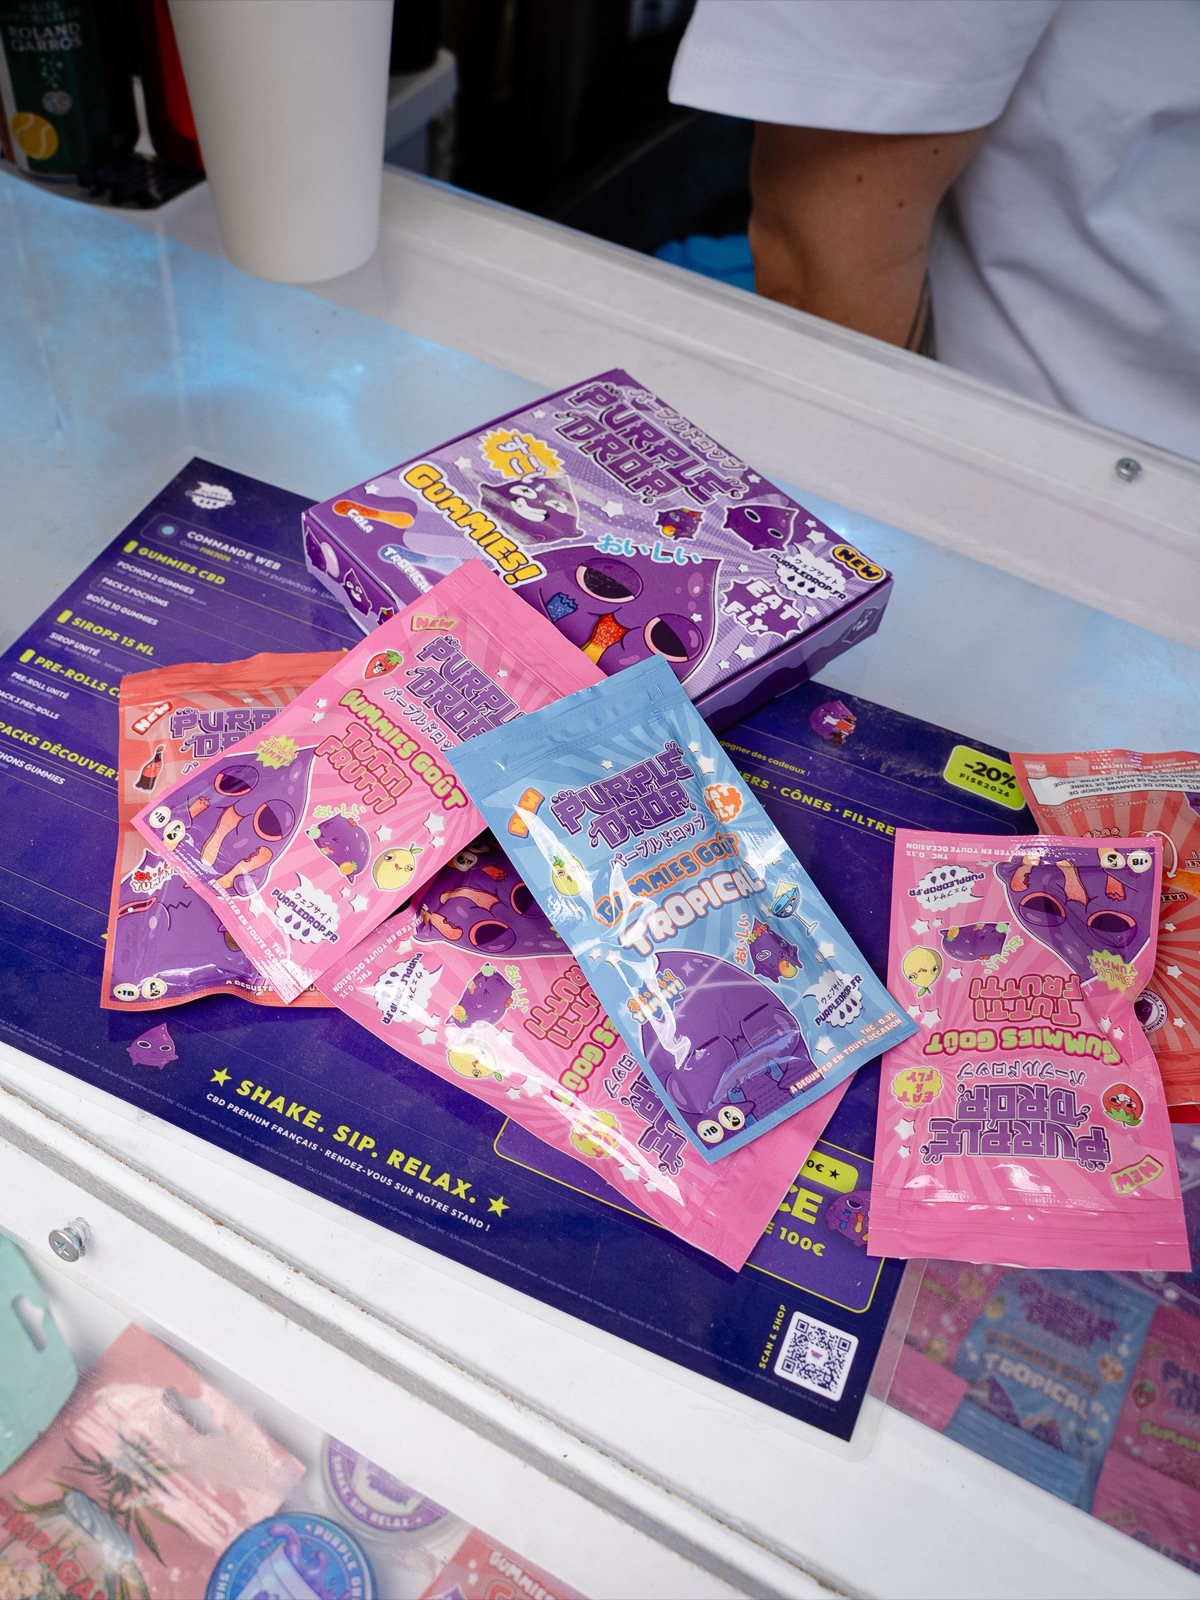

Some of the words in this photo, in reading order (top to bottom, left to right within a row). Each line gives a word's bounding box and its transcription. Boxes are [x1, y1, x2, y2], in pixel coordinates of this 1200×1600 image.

[554, 411, 682, 505] DROP
[565, 382, 749, 505] PURPLE
[346, 508, 374, 534] COLA
[402, 462, 546, 586] GUMMIES!
[186, 530, 253, 560] COMMANDE
[254, 555, 281, 571] WEB
[595, 533, 702, 566] おいしい
[838, 548, 881, 580] NEW
[115, 559, 152, 579] POCHON
[151, 573, 157, 581] 2
[156, 576, 195, 595] GUMMIES
[138, 547, 198, 574] GUMMIES
[198, 569, 225, 585] CBD
[770, 553, 847, 601] PURPLEDROP.FR
[795, 557, 838, 585] ウェブサイト
[100, 576, 123, 590] PACK
[122, 584, 130, 592] 2
[128, 587, 169, 607] POCHONS
[746, 578, 801, 621] EAT
[86, 592, 110, 608] BOÎTE
[110, 602, 122, 612] 10
[120, 607, 159, 626] GUMMIES
[414, 616, 456, 630] NEW
[724, 600, 769, 632] FLY
[751, 602, 768, 616] &
[48, 631, 76, 647] SIROP
[73, 640, 101, 657] UNITÉ
[70, 615, 120, 642] SIROPS
[119, 634, 136, 648] 15
[134, 641, 155, 656] ML
[10, 671, 46, 690] PRE-ROLL
[45, 684, 70, 700] UNITÉ
[34, 656, 108, 692] PRE-ROLLS
[18, 698, 60, 720] PRE-ROLLS
[135, 702, 170, 733] NEW
[0, 722, 40, 746] PACKS
[338, 688, 420, 760] GUMMIES
[409, 751, 468, 810] GOÛT
[256, 743, 292, 766] YUMMY!
[342, 722, 412, 798] TUTTI
[718, 739, 751, 756] gagner
[750, 750, 767, 761] des
[766, 755, 806, 775] cadeaux
[24, 763, 66, 786] GUMMIES
[314, 735, 397, 814] FRUTTI
[551, 740, 694, 834] PURPLE
[959, 772, 1010, 798] FISE2026
[964, 761, 1016, 790] -20%
[155, 811, 166, 824] +18
[314, 803, 366, 819] おいしい
[588, 780, 697, 849] DROP
[779, 784, 833, 812] CÔNES
[841, 809, 899, 837] FILTRE
[611, 813, 706, 870] パープルドロップ
[693, 832, 740, 873] GOÛT
[1132, 858, 1149, 867] +18
[908, 872, 984, 897] PURPLEDROP.FR
[926, 886, 968, 903] ウェブサイト
[213, 884, 241, 915] DEGUSTER
[238, 913, 248, 926] EN
[245, 925, 268, 951] TOUTE
[272, 888, 338, 943] PURPLEDROP.FR
[294, 892, 332, 924] ウェブサイト
[619, 865, 766, 957] TROPICAL
[272, 942, 286, 958] THC
[366, 943, 388, 964] TOUTE
[386, 933, 397, 946] EN
[734, 914, 750, 966] おいしい
[984, 934, 1024, 974] おいしい
[332, 962, 366, 992] OCCASION
[356, 969, 372, 984] THC
[1088, 954, 1138, 973] YUMMY!
[338, 984, 356, 1000] 0.3%
[505, 964, 530, 1013] おいしい
[814, 974, 862, 1027] PURPLEDROP.FR
[820, 978, 845, 1005] ウェブサイト
[968, 974, 1084, 1000] FRUTTI
[860, 1024, 876, 1036] THC
[878, 1011, 897, 1026] 0.3%
[974, 1000, 1080, 1027] TUTTI
[790, 1084, 796, 1094] A
[796, 1061, 834, 1090] DEGUSTER
[832, 1053, 845, 1066] EN
[843, 1036, 868, 1060] TOUTE
[867, 1018, 903, 1042] OCCASION
[924, 1028, 998, 1056] GOÛT
[1001, 1026, 1124, 1065] GUMMIES
[905, 1070, 934, 1083] FLY
[956, 1060, 1086, 1086] パープルドロップ
[898, 1091, 934, 1103] EAT
[956, 1083, 1091, 1128] DROP
[234, 1077, 329, 1133] SHAKE.
[332, 1123, 383, 1158] SIP.
[385, 1148, 480, 1204] RELAX.
[703, 1124, 719, 1137] +18
[920, 1117, 1112, 1172] PURPLE
[205, 1092, 226, 1107] CBD
[226, 1102, 270, 1128] PREMIUM
[269, 1123, 318, 1152] FRANÇAIS
[324, 1149, 394, 1186] RENDEZ-VOUS
[394, 1182, 415, 1197] SUR
[415, 1192, 449, 1213] NOTRE
[450, 1208, 484, 1229] STAND
[1114, 1160, 1164, 1192] NEW
[780, 1226, 827, 1257] 100€
[758, 1346, 772, 1369] SCAN
[773, 1304, 787, 1332] SHOP
[983, 1352, 1089, 1421] TROPICAL
